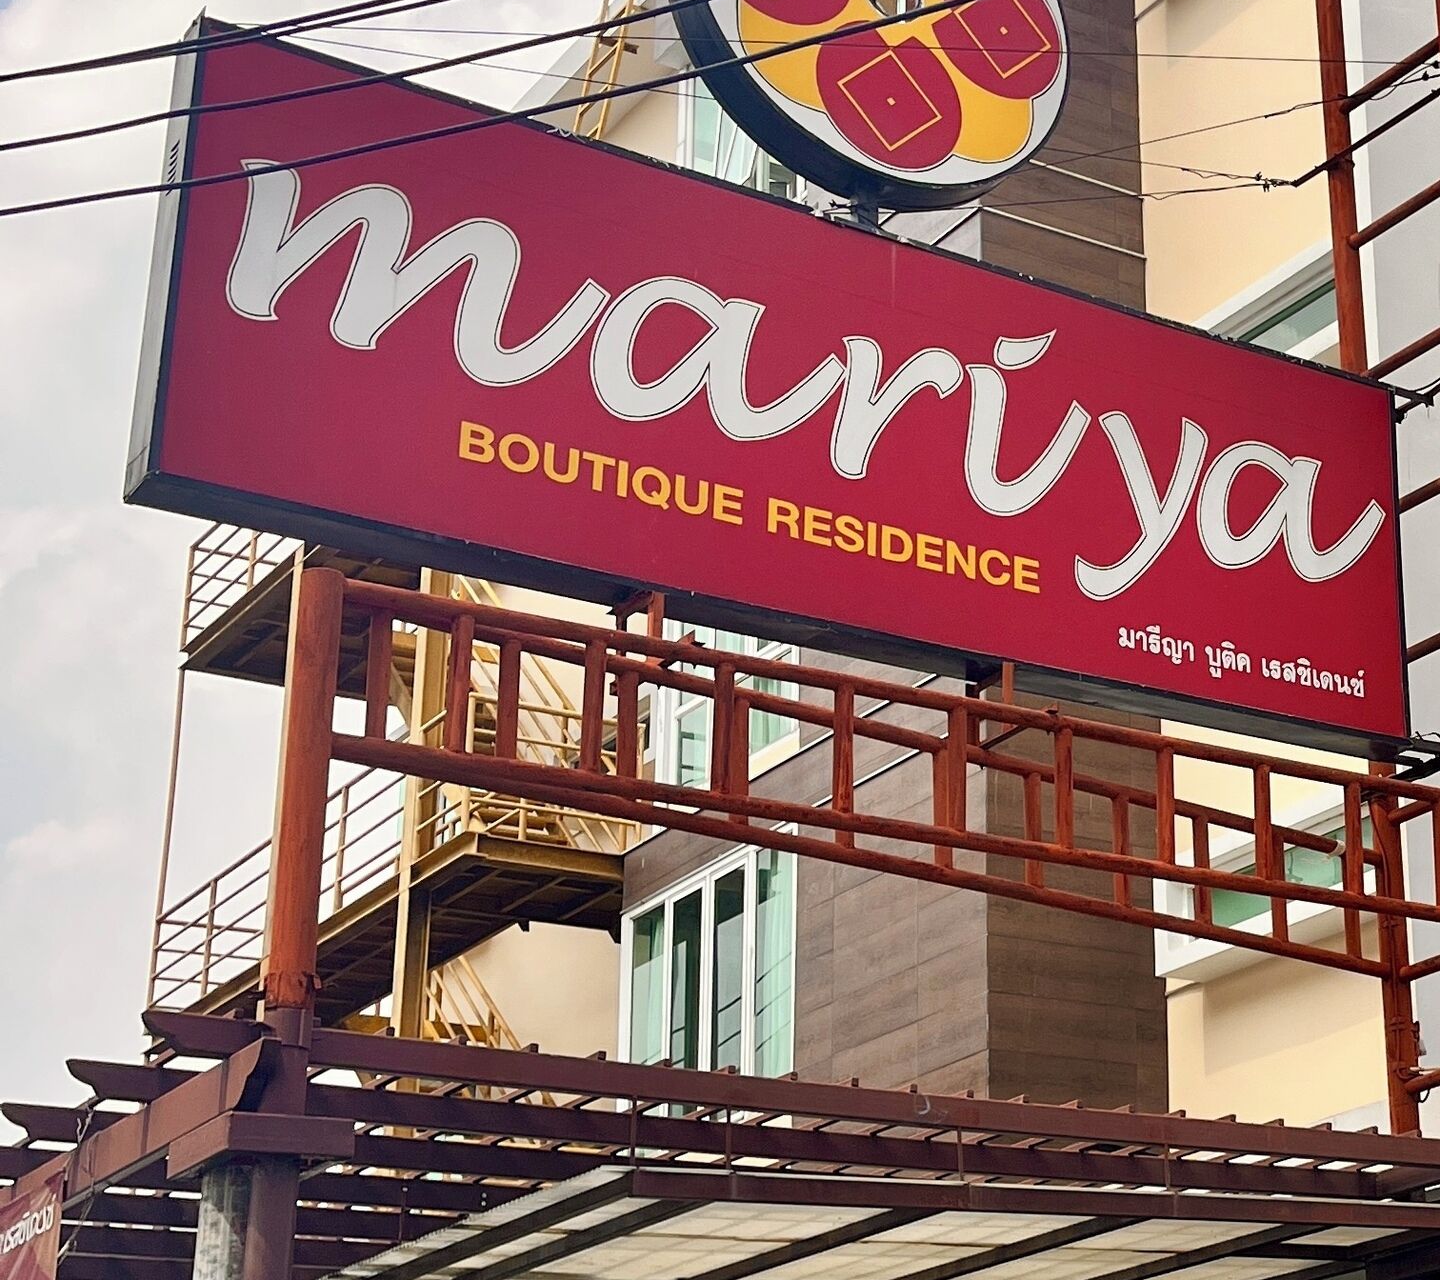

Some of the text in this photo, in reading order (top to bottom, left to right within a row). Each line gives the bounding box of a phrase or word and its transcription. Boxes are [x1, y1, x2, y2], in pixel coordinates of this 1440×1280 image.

[226, 158, 1386, 601] mariya
[458, 420, 1042, 594] BOUTIQUE RESIDENCE
[1117, 624, 1366, 698] มารีญา บูติค เรสซิเดนซ์
